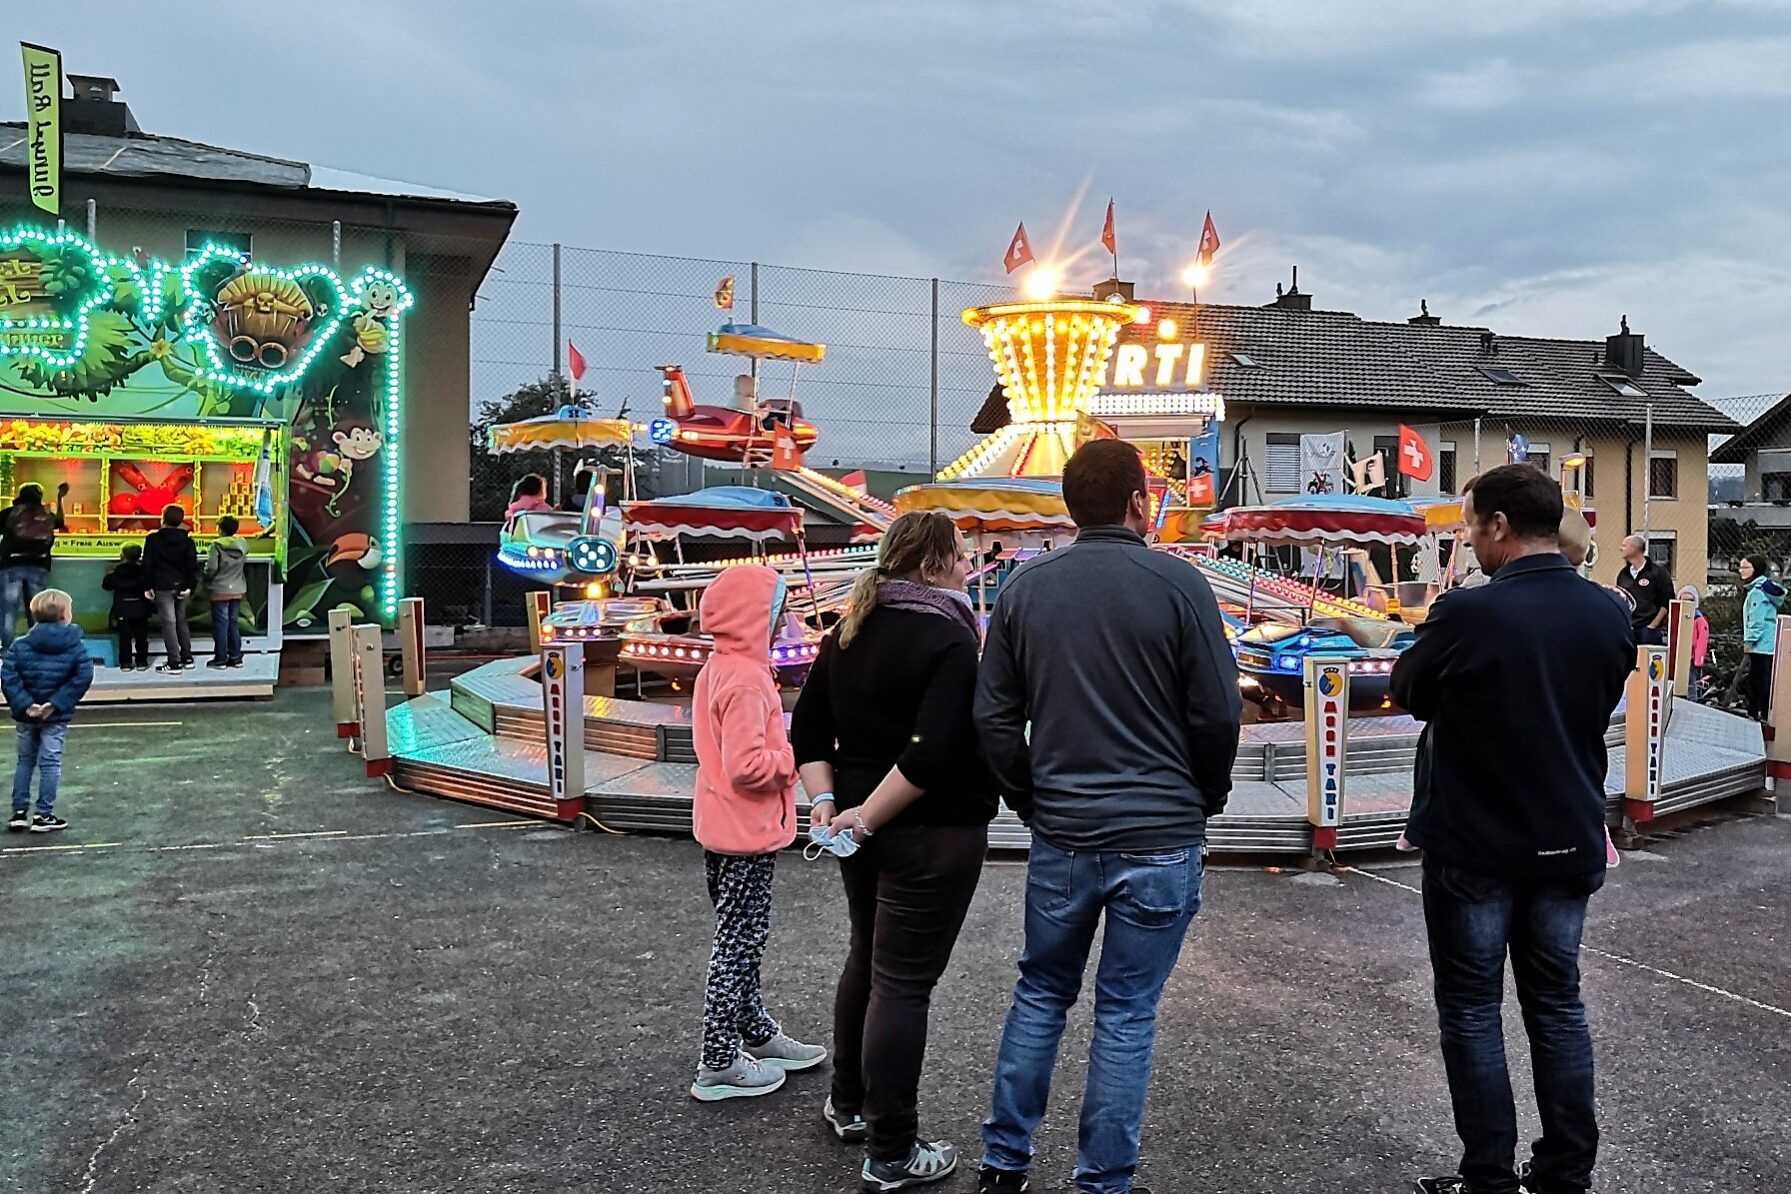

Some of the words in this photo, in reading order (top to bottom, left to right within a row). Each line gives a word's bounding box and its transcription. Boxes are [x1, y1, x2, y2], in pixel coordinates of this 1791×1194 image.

[70, 539, 93, 547] Freie
[1324, 762, 1337, 820] TAXI
[1649, 742, 1658, 795] TAXI
